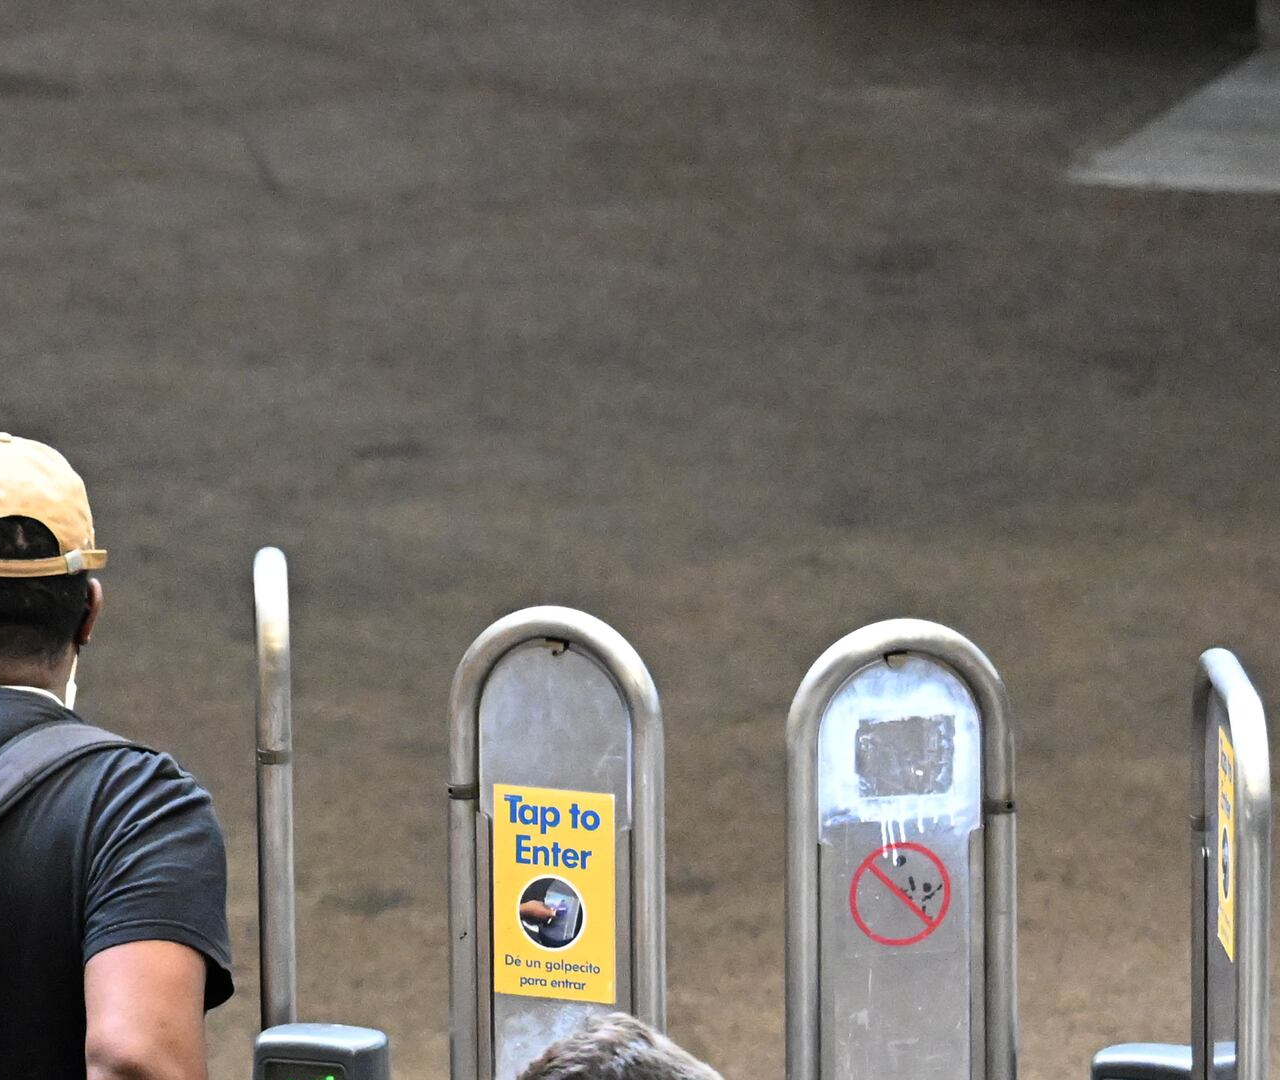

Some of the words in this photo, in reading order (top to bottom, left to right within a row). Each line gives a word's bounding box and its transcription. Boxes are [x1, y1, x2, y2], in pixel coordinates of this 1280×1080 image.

[504, 794, 560, 834] Tap
[569, 803, 600, 831] to
[516, 834, 592, 870] Enter
[505, 954, 521, 967] Dé
[526, 957, 540, 968] un
[545, 959, 600, 974] golpecito
[520, 976, 547, 987] para
[551, 977, 586, 990] entrar
